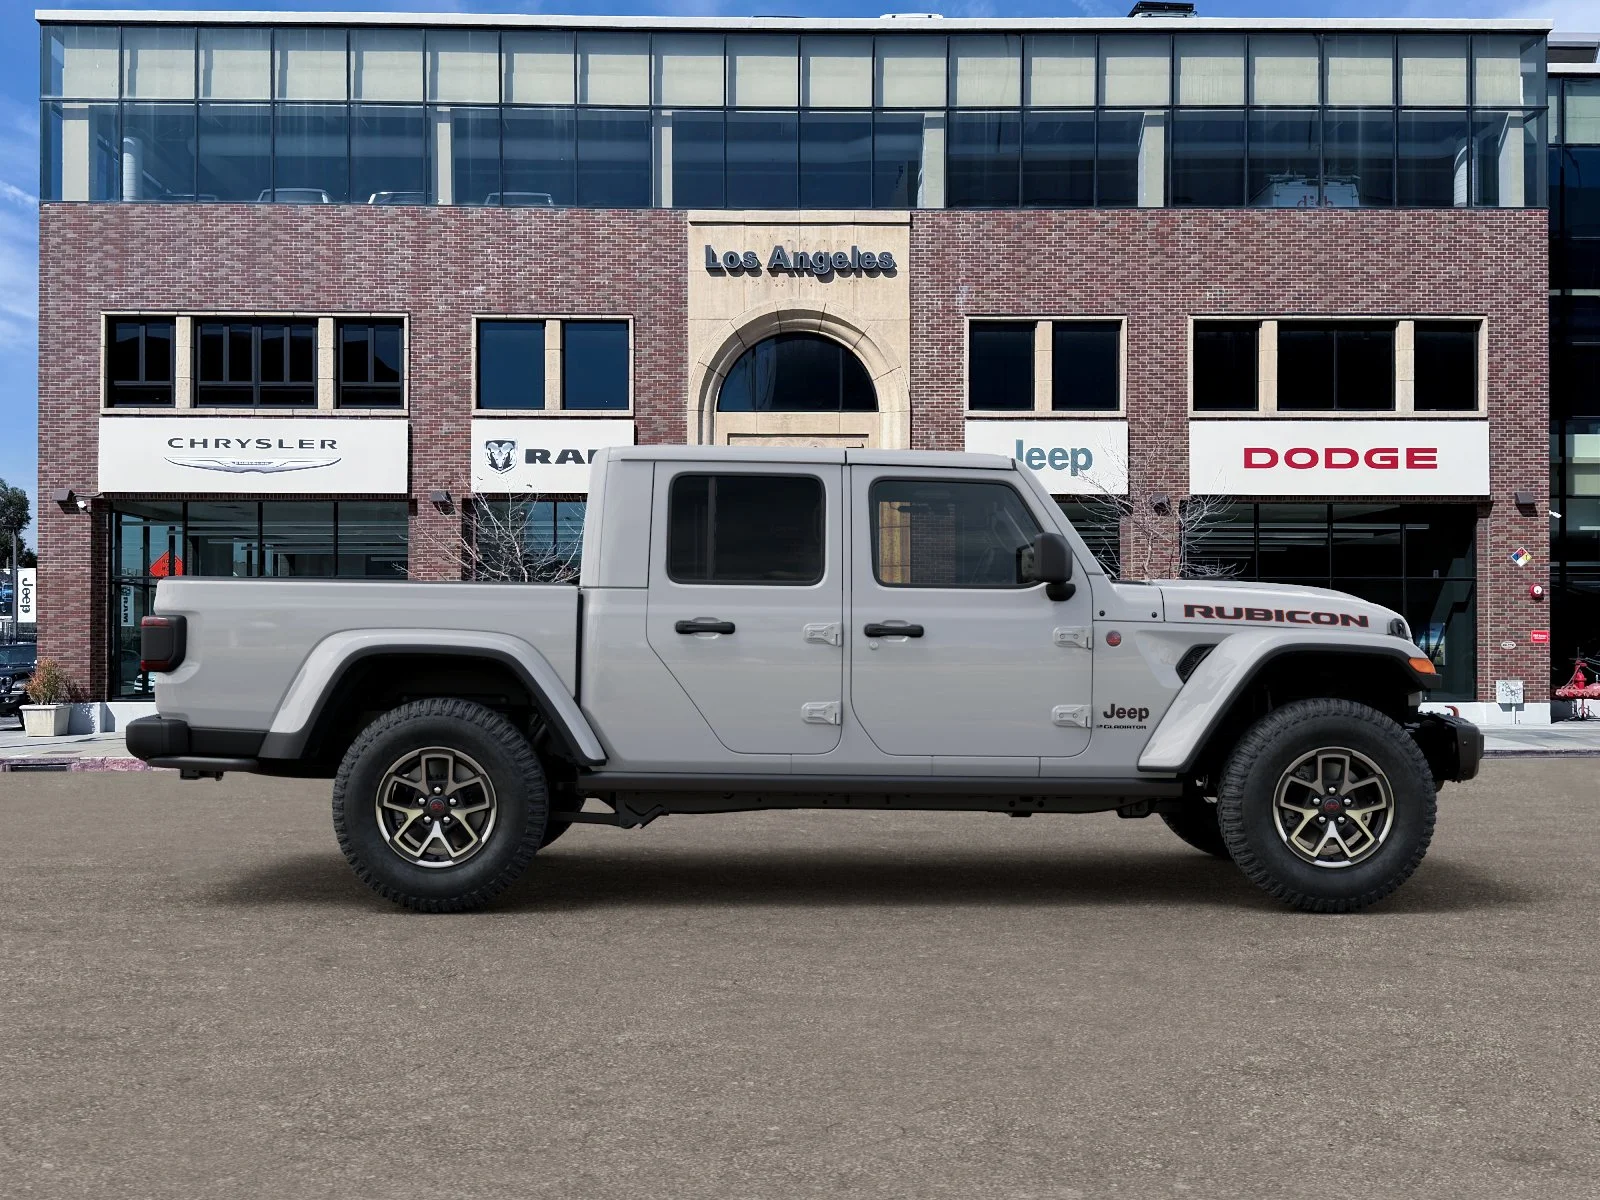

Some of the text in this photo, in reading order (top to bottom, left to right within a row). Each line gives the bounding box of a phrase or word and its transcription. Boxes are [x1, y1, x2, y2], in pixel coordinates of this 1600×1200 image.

[704, 244, 895, 275] Los Angeles
[167, 437, 339, 450] CHRYSLER
[1243, 447, 1438, 469] DODGE
[20, 577, 34, 614] Jeep
[1184, 604, 1369, 628] RUBICON
[1102, 703, 1150, 722] Jeep
